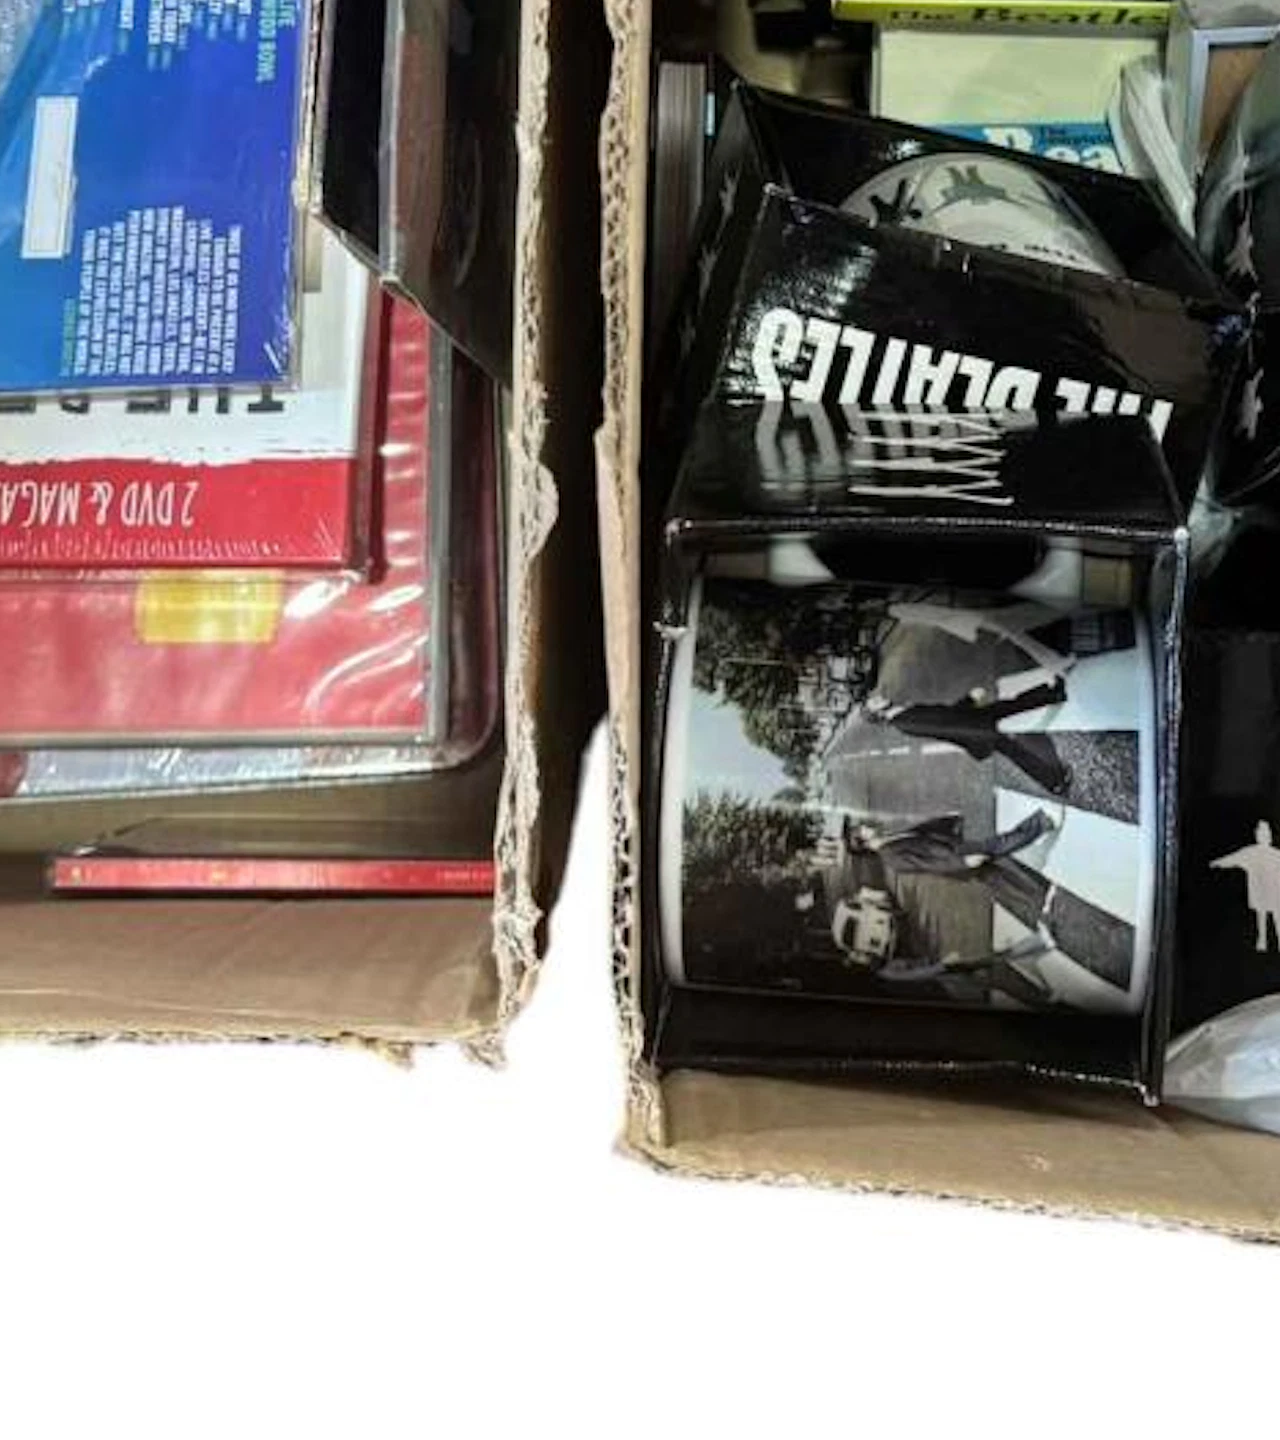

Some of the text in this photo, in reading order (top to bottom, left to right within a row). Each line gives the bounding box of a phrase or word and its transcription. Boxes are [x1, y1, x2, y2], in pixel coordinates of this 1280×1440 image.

[90, 479, 113, 526] &
[119, 480, 175, 525] DVD
[179, 479, 200, 529] 2
